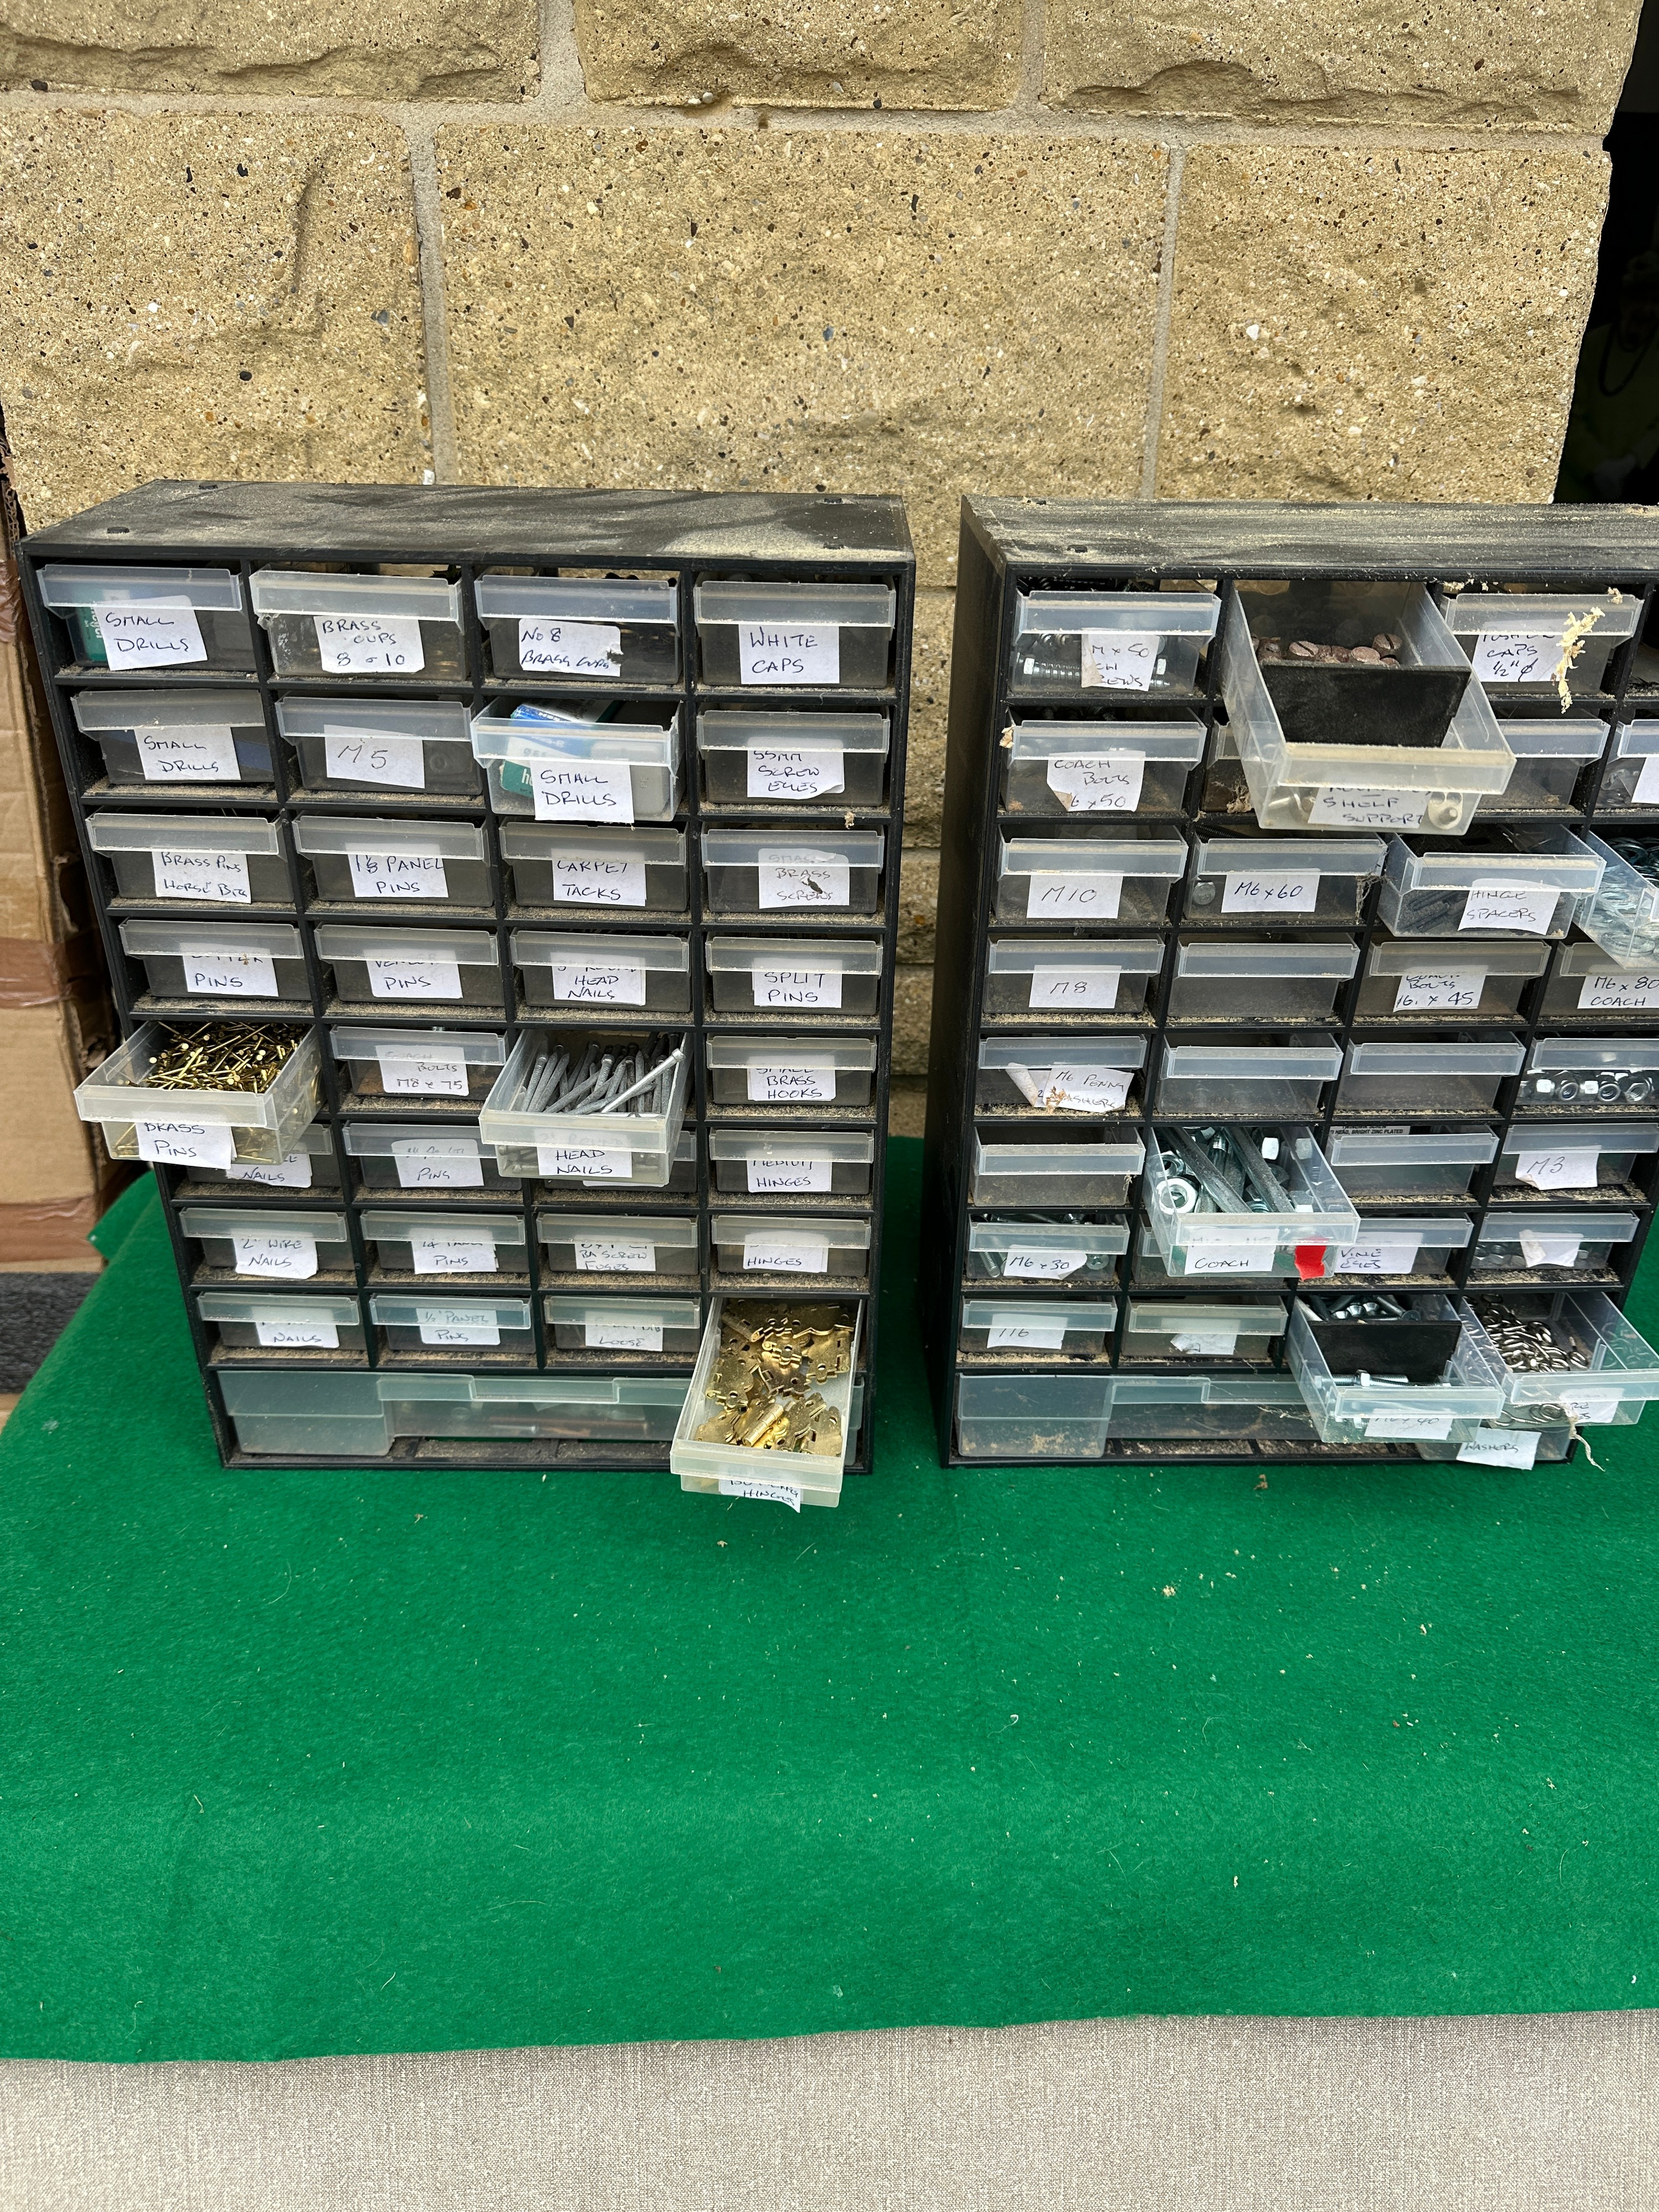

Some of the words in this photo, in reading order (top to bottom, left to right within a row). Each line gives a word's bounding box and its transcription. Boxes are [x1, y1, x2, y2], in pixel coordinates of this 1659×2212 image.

[106, 612, 175, 627] SMALL
[322, 619, 381, 634] BRASS
[354, 633, 397, 645] CUPS
[750, 628, 818, 648] WHITE
[113, 638, 190, 653] DRILLS
[1487, 644, 1537, 657] CAPS
[385, 653, 405, 666] 10
[521, 650, 570, 666] BRASS
[753, 660, 805, 674] CAPS
[144, 735, 207, 750] SMALL
[338, 745, 388, 769] M5
[161, 760, 220, 773] DRILLS
[758, 765, 819, 777] SCREW
[1054, 760, 1110, 769] COACH
[540, 770, 609, 784] SMALL
[542, 791, 617, 806] DRILLS
[1100, 794, 1126, 807] 50
[1323, 797, 1399, 808] SHELF
[1343, 813, 1424, 824] SUPPORT
[161, 852, 210, 867] BRASS
[387, 856, 444, 873] PANEL
[557, 860, 627, 873] CARPET
[775, 868, 830, 879] BRASS
[377, 881, 420, 894] PINS
[562, 884, 620, 900] TACKS
[1041, 886, 1097, 902] M10
[1467, 908, 1536, 922] SPACERS
[195, 973, 243, 987] PINS
[384, 976, 431, 990] PINS
[575, 975, 619, 985] HEAD
[764, 972, 826, 985] SPLIT
[1635, 976, 1659, 989] 80
[568, 987, 615, 999] NAILS
[768, 990, 818, 1003] PINS
[1448, 992, 1474, 1005] 45
[1590, 997, 1646, 1006] COACH
[416, 1062, 457, 1072] BOLTS
[441, 1081, 462, 1089] 75
[766, 1075, 816, 1086] BRASS
[768, 1088, 822, 1099] HOOKS
[154, 1140, 197, 1157] PINS
[555, 1150, 605, 1160] HEAD
[557, 1165, 612, 1175] NAILS
[1526, 1156, 1564, 1173] M3
[242, 1167, 285, 1182] NAILS
[417, 1167, 450, 1181] PINS
[757, 1177, 811, 1187] HINGES
[249, 1254, 292, 1267] NAILS
[434, 1255, 468, 1265] PINS
[748, 1256, 802, 1266] HINGES
[1009, 1256, 1034, 1267] M6
[1050, 1260, 1069, 1270] 30
[1194, 1258, 1249, 1269] COACH
[274, 1332, 322, 1343] NAILS
[435, 1329, 469, 1342] PINS
[599, 1336, 645, 1347] LOOSE
